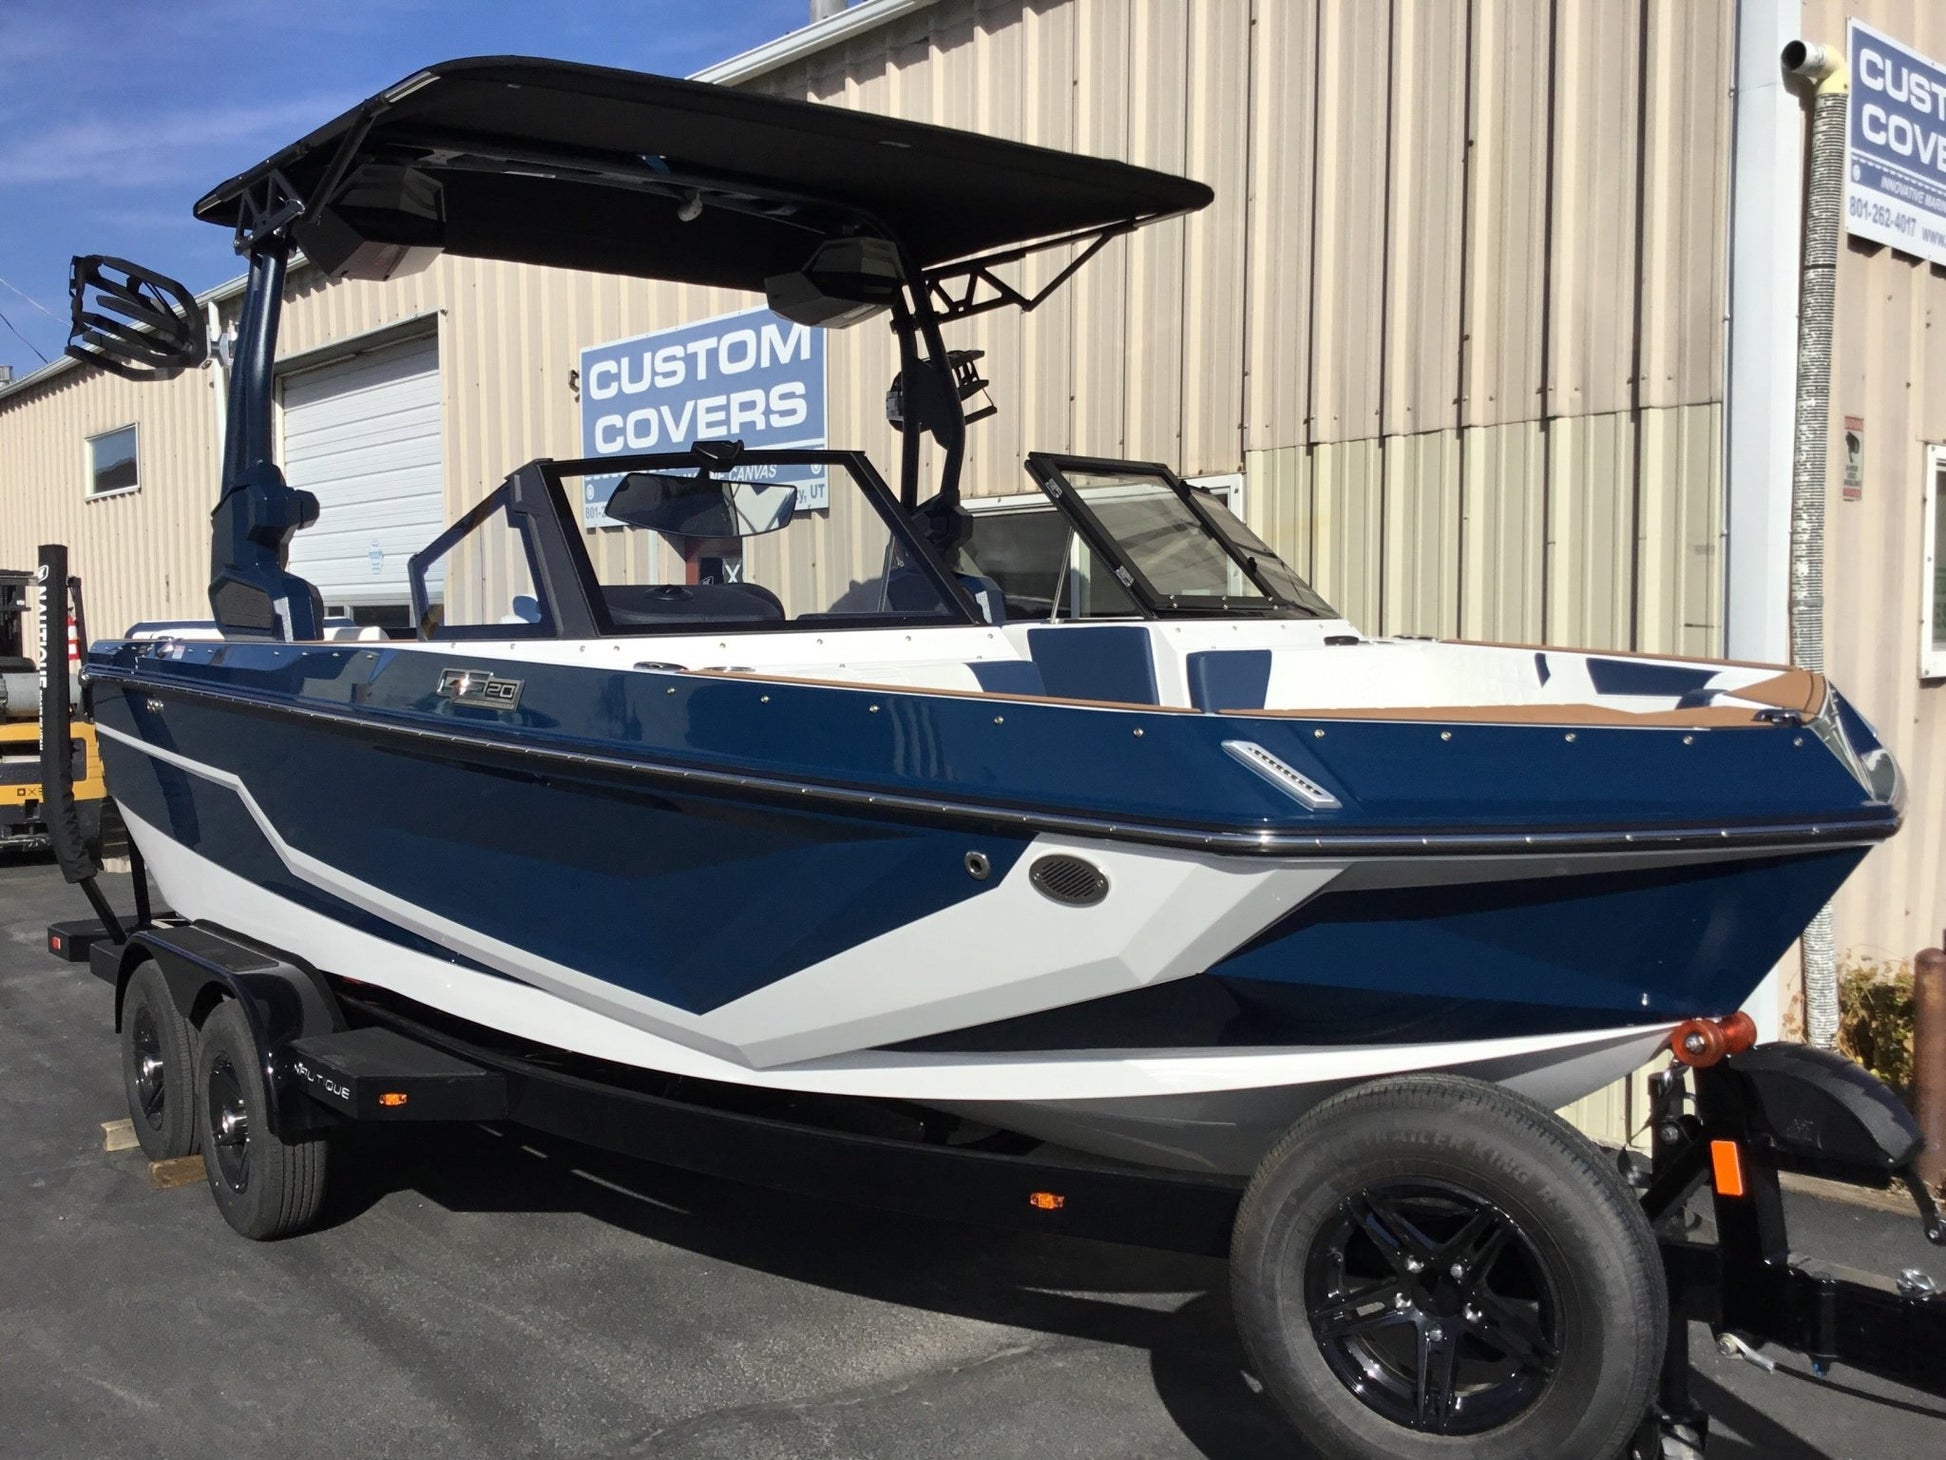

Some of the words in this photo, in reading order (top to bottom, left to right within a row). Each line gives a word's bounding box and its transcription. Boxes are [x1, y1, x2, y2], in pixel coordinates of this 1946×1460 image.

[1880, 175, 1925, 205] INNOVATIVE
[1850, 195, 1916, 237] 801-262-4017
[589, 323, 811, 400] CUSTOM
[594, 381, 807, 454] COVERS
[728, 464, 777, 482] CANVAS
[810, 484, 825, 499] UT
[294, 1062, 351, 1100] NAUTIQUE
